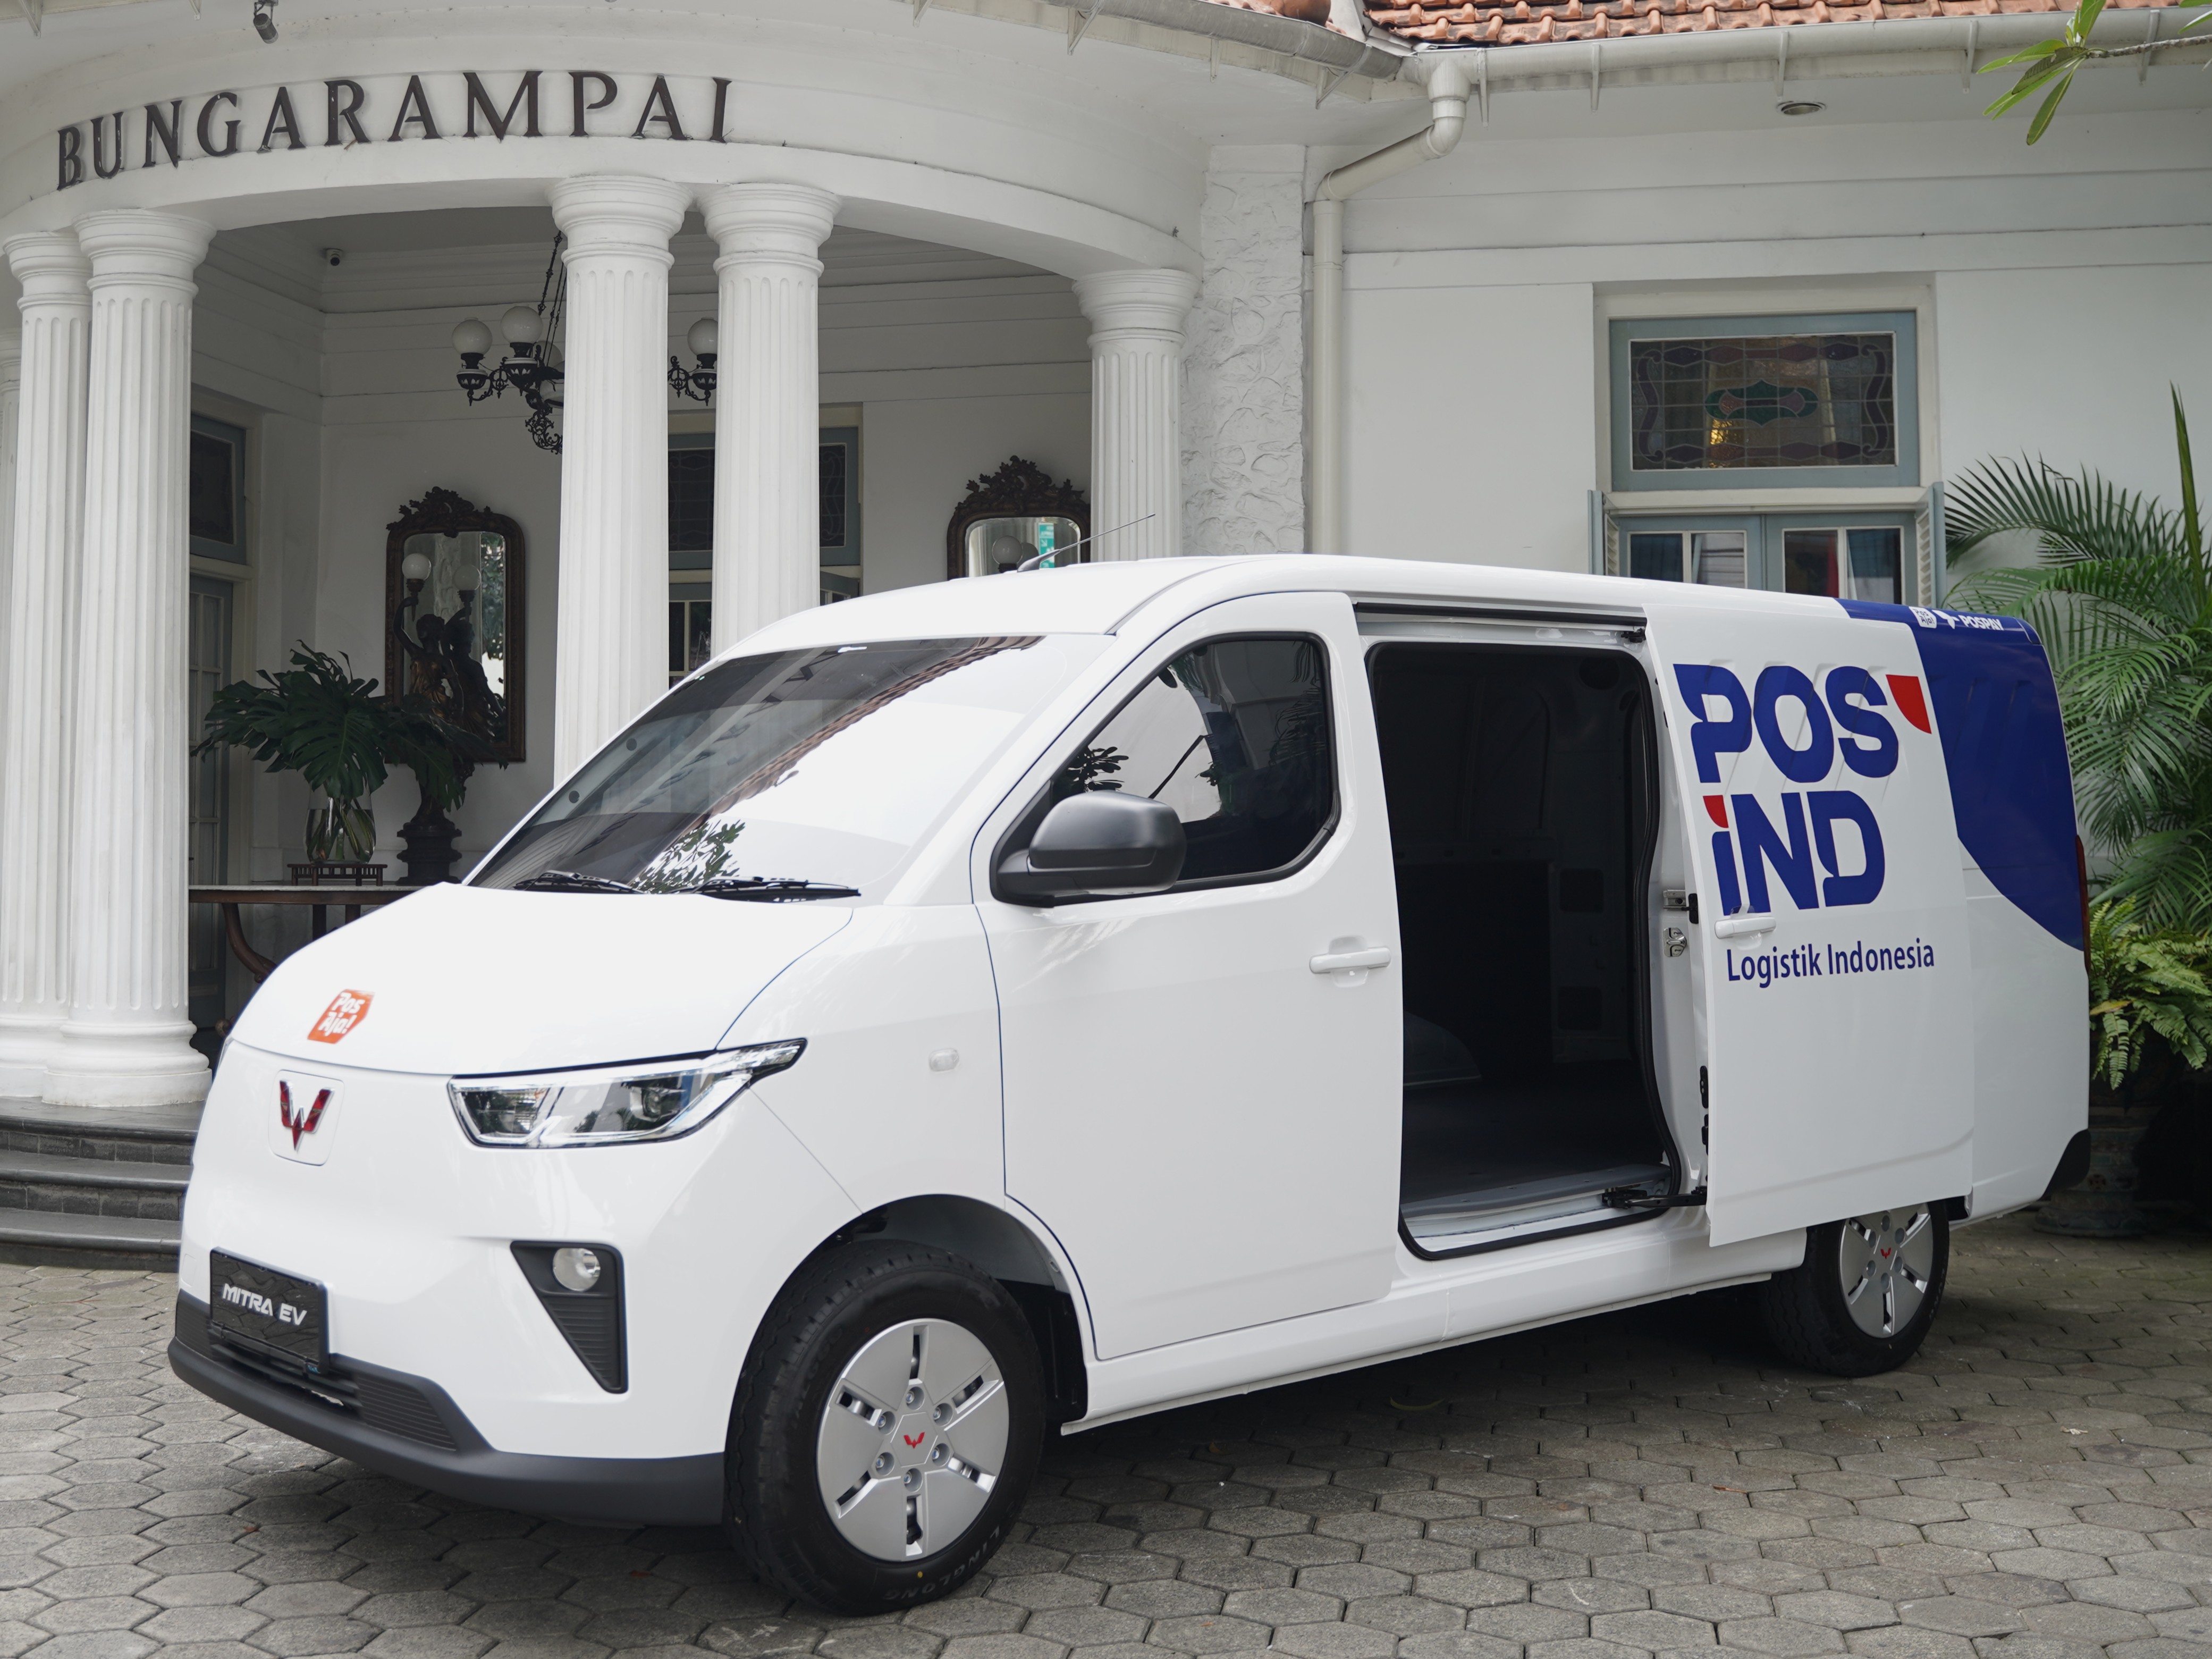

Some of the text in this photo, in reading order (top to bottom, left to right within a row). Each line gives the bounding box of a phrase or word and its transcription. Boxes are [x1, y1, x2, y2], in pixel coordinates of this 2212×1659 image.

[56, 70, 733, 191] BUNGARAMPAI
[1958, 614, 2004, 631] POSPAY
[1673, 663, 1899, 784] POS
[1726, 938, 1935, 989] Logistik Indonesia
[222, 1283, 308, 1326] MITRA EV
[882, 1525, 1000, 1600] LINGLONG
